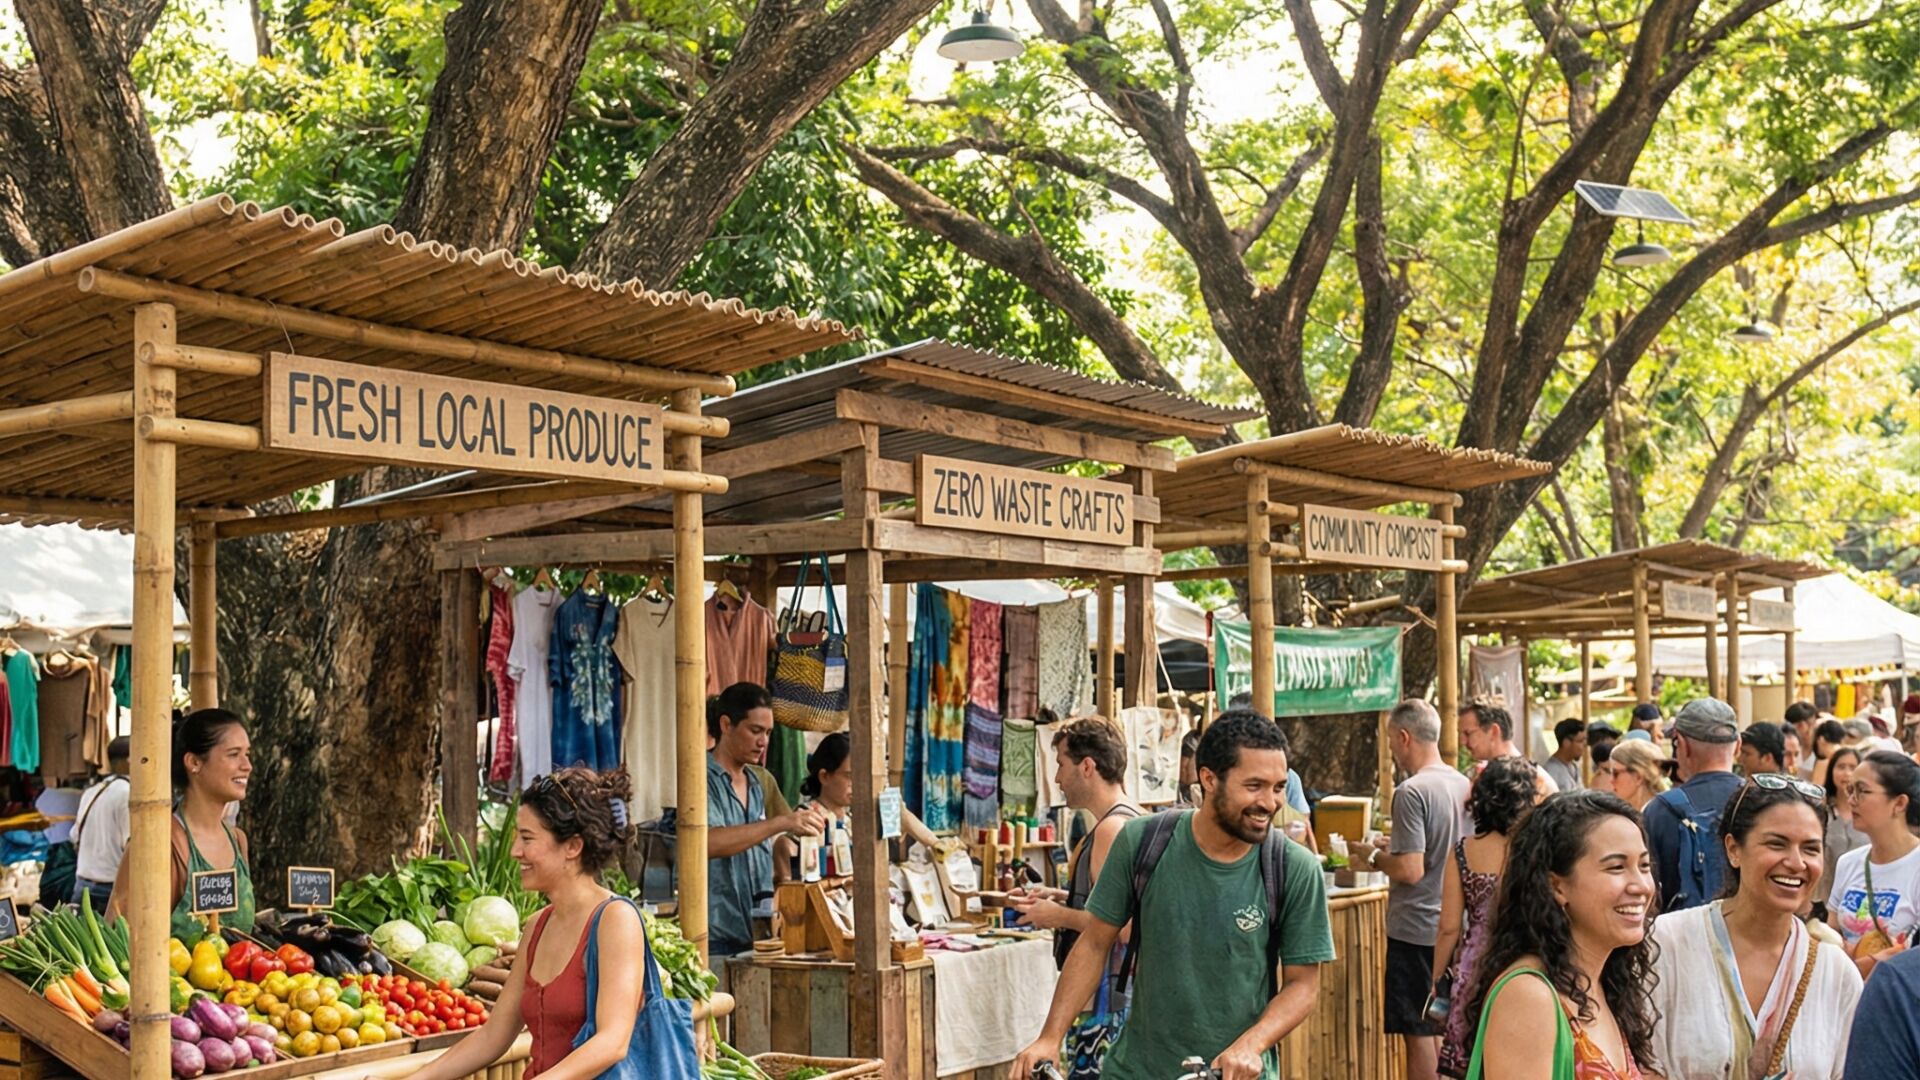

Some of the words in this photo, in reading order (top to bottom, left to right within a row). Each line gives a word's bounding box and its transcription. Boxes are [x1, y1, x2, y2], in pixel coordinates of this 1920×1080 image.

[289, 372, 401, 444] FRESH
[418, 389, 516, 456] LOCAL
[529, 402, 652, 470] PRODUCE
[934, 468, 984, 519] ZERO
[990, 476, 1052, 527] WASTE
[1060, 486, 1125, 535] CRAFTS
[1309, 514, 1381, 556] COMMUNITY
[1386, 523, 1437, 562] COMPOST
